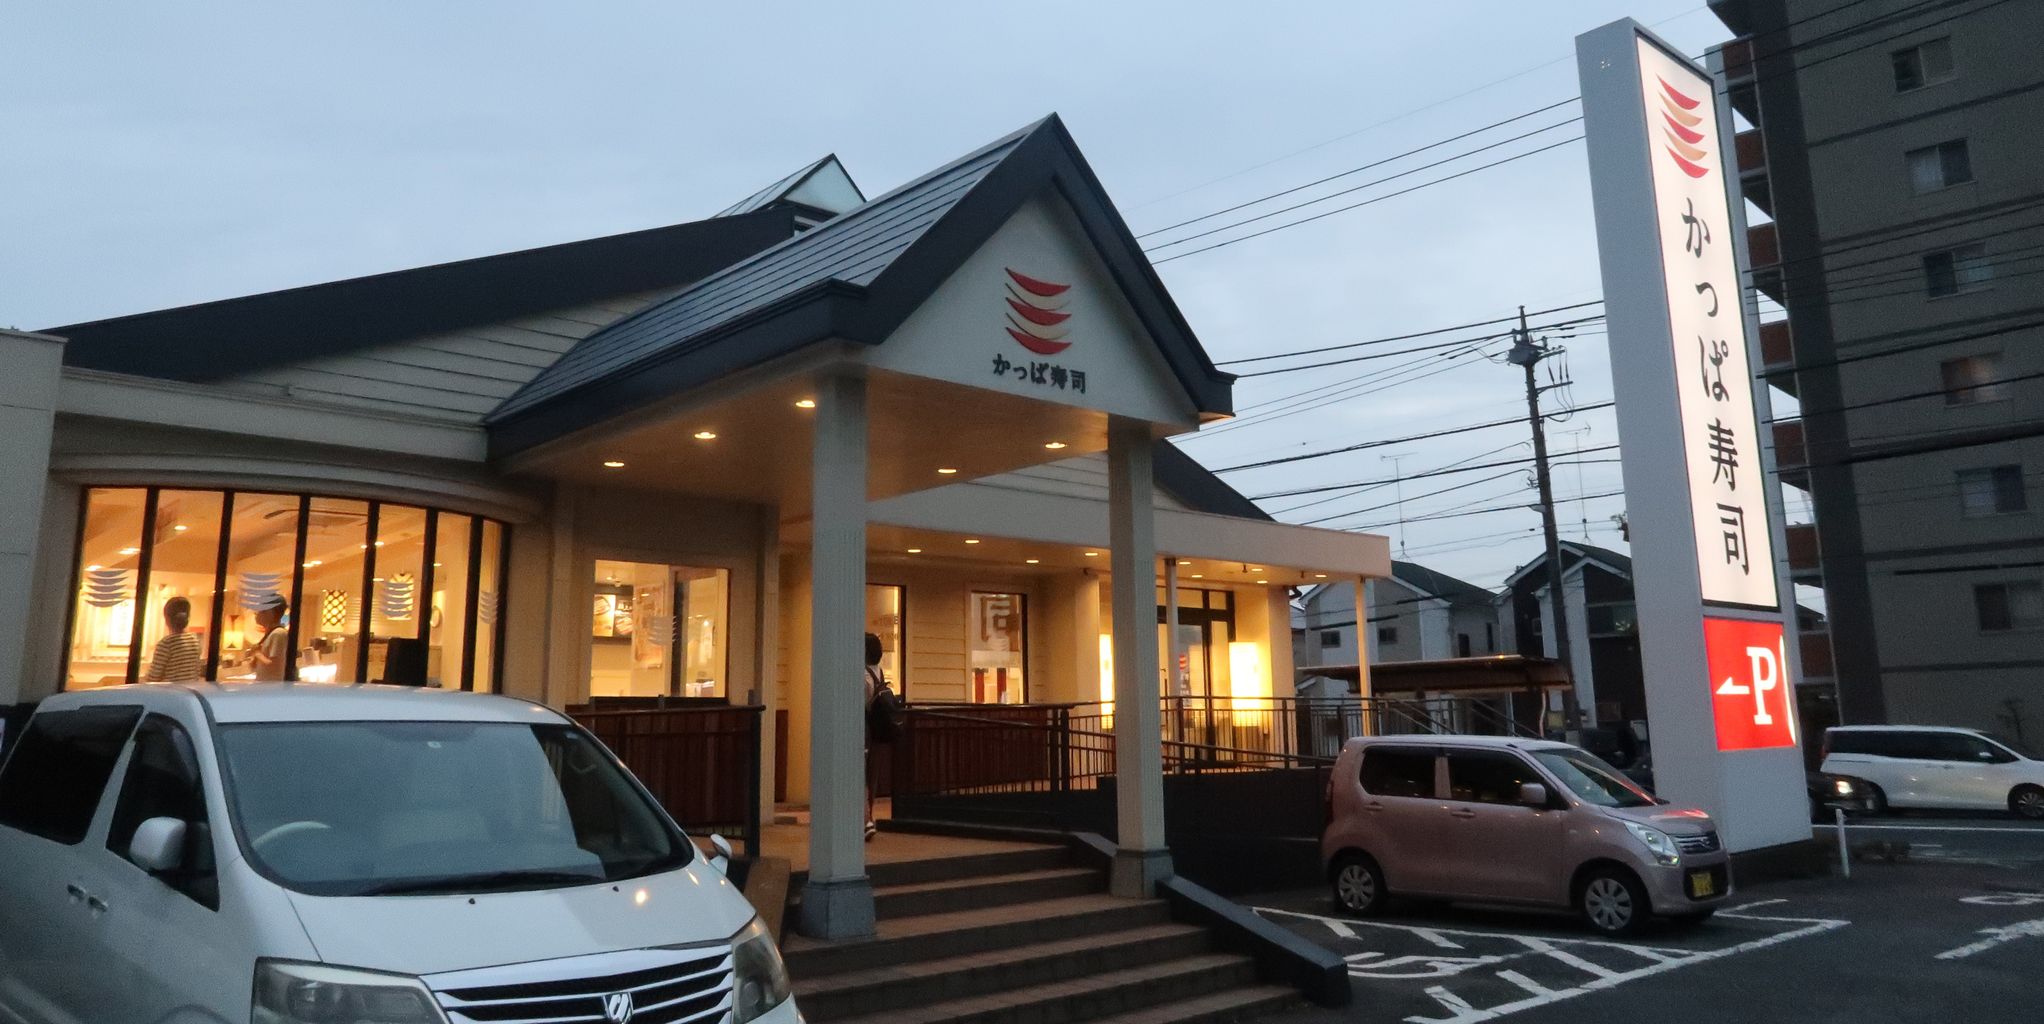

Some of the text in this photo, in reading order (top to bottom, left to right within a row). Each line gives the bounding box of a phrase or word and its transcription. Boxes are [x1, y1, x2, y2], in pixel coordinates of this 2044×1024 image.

[992, 353, 1086, 394] かっぱ寿司
[1681, 197, 1749, 576] かっぱ寿司
[1746, 646, 1777, 725] P
